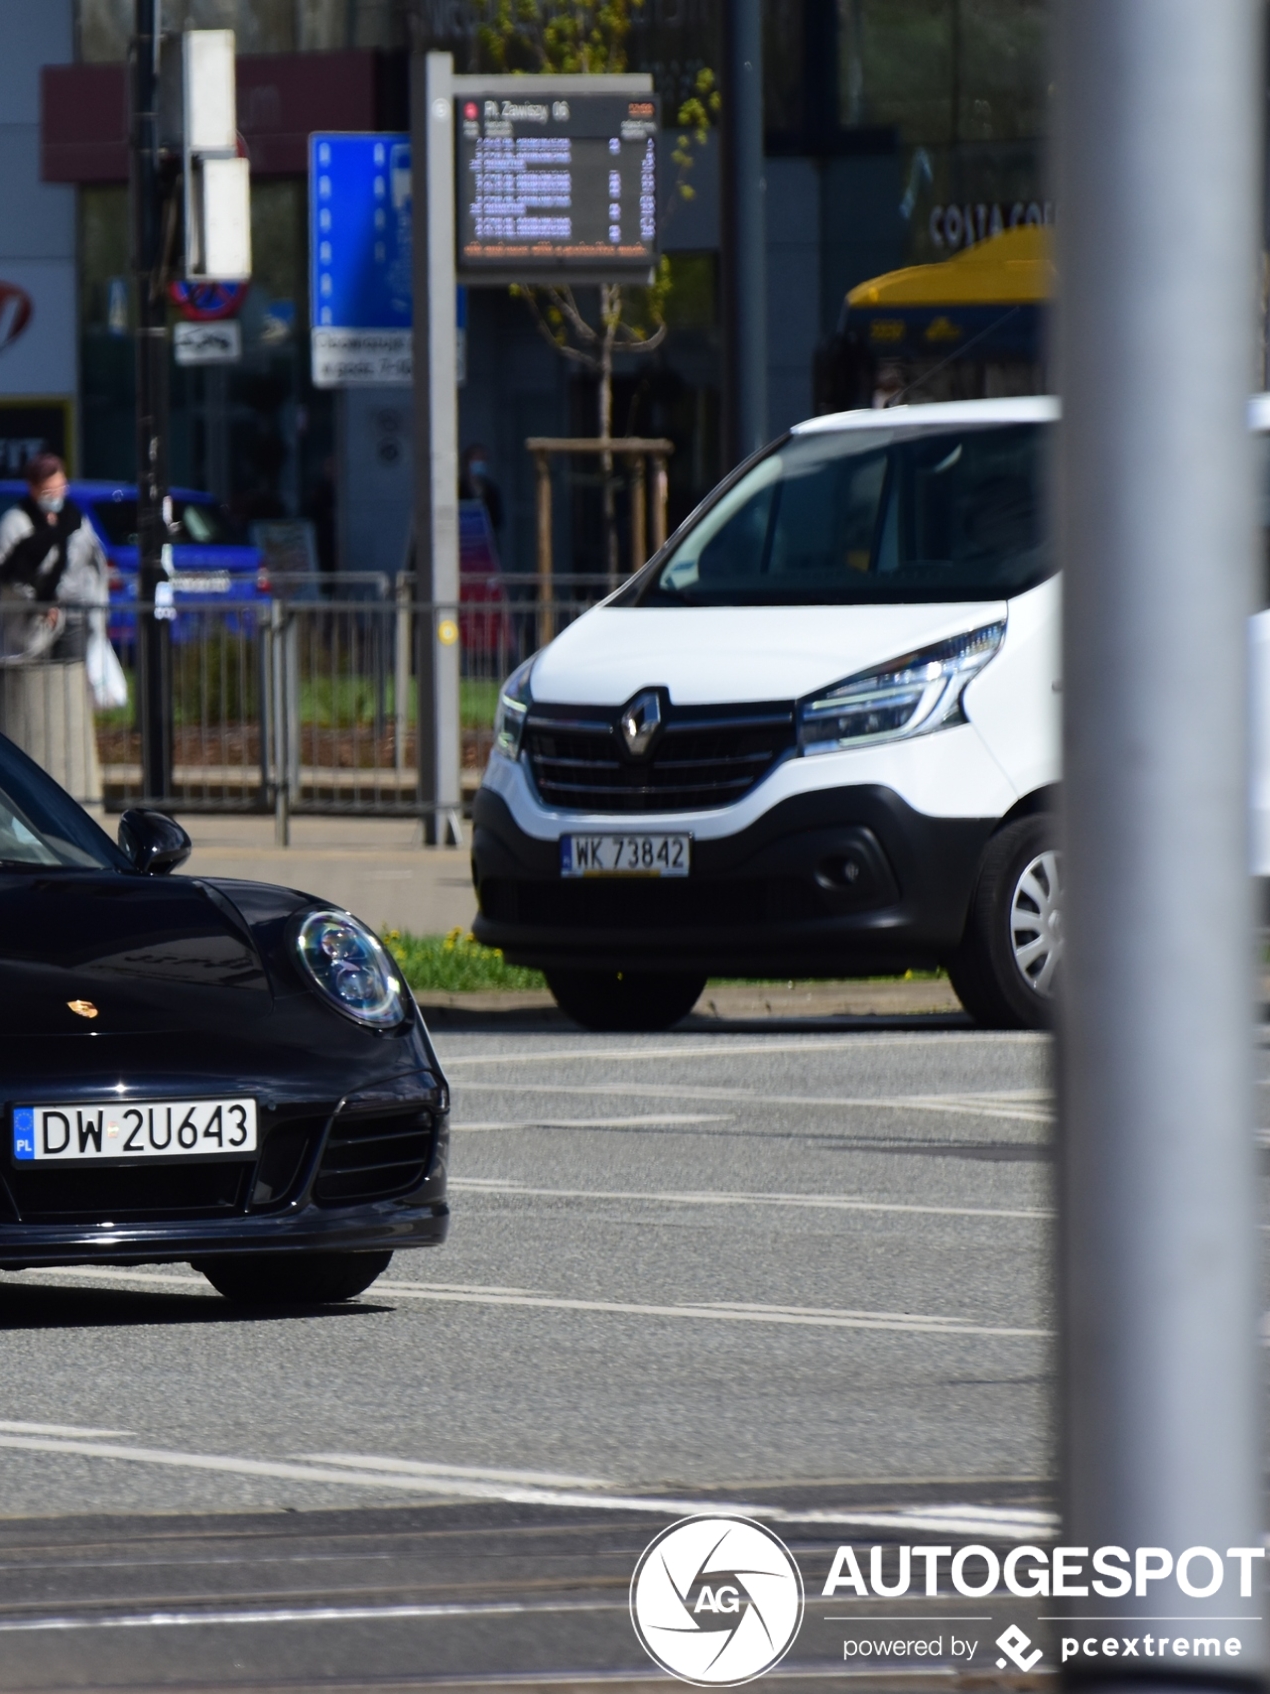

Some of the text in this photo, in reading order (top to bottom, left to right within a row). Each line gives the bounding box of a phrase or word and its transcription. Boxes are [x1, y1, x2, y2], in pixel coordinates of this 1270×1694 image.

[502, 101, 548, 124] Zawiszy
[931, 204, 1003, 247] COSTA
[575, 836, 684, 869] WK 73842
[42, 1104, 247, 1154] DW 2U643
[17, 1140, 32, 1152] PL
